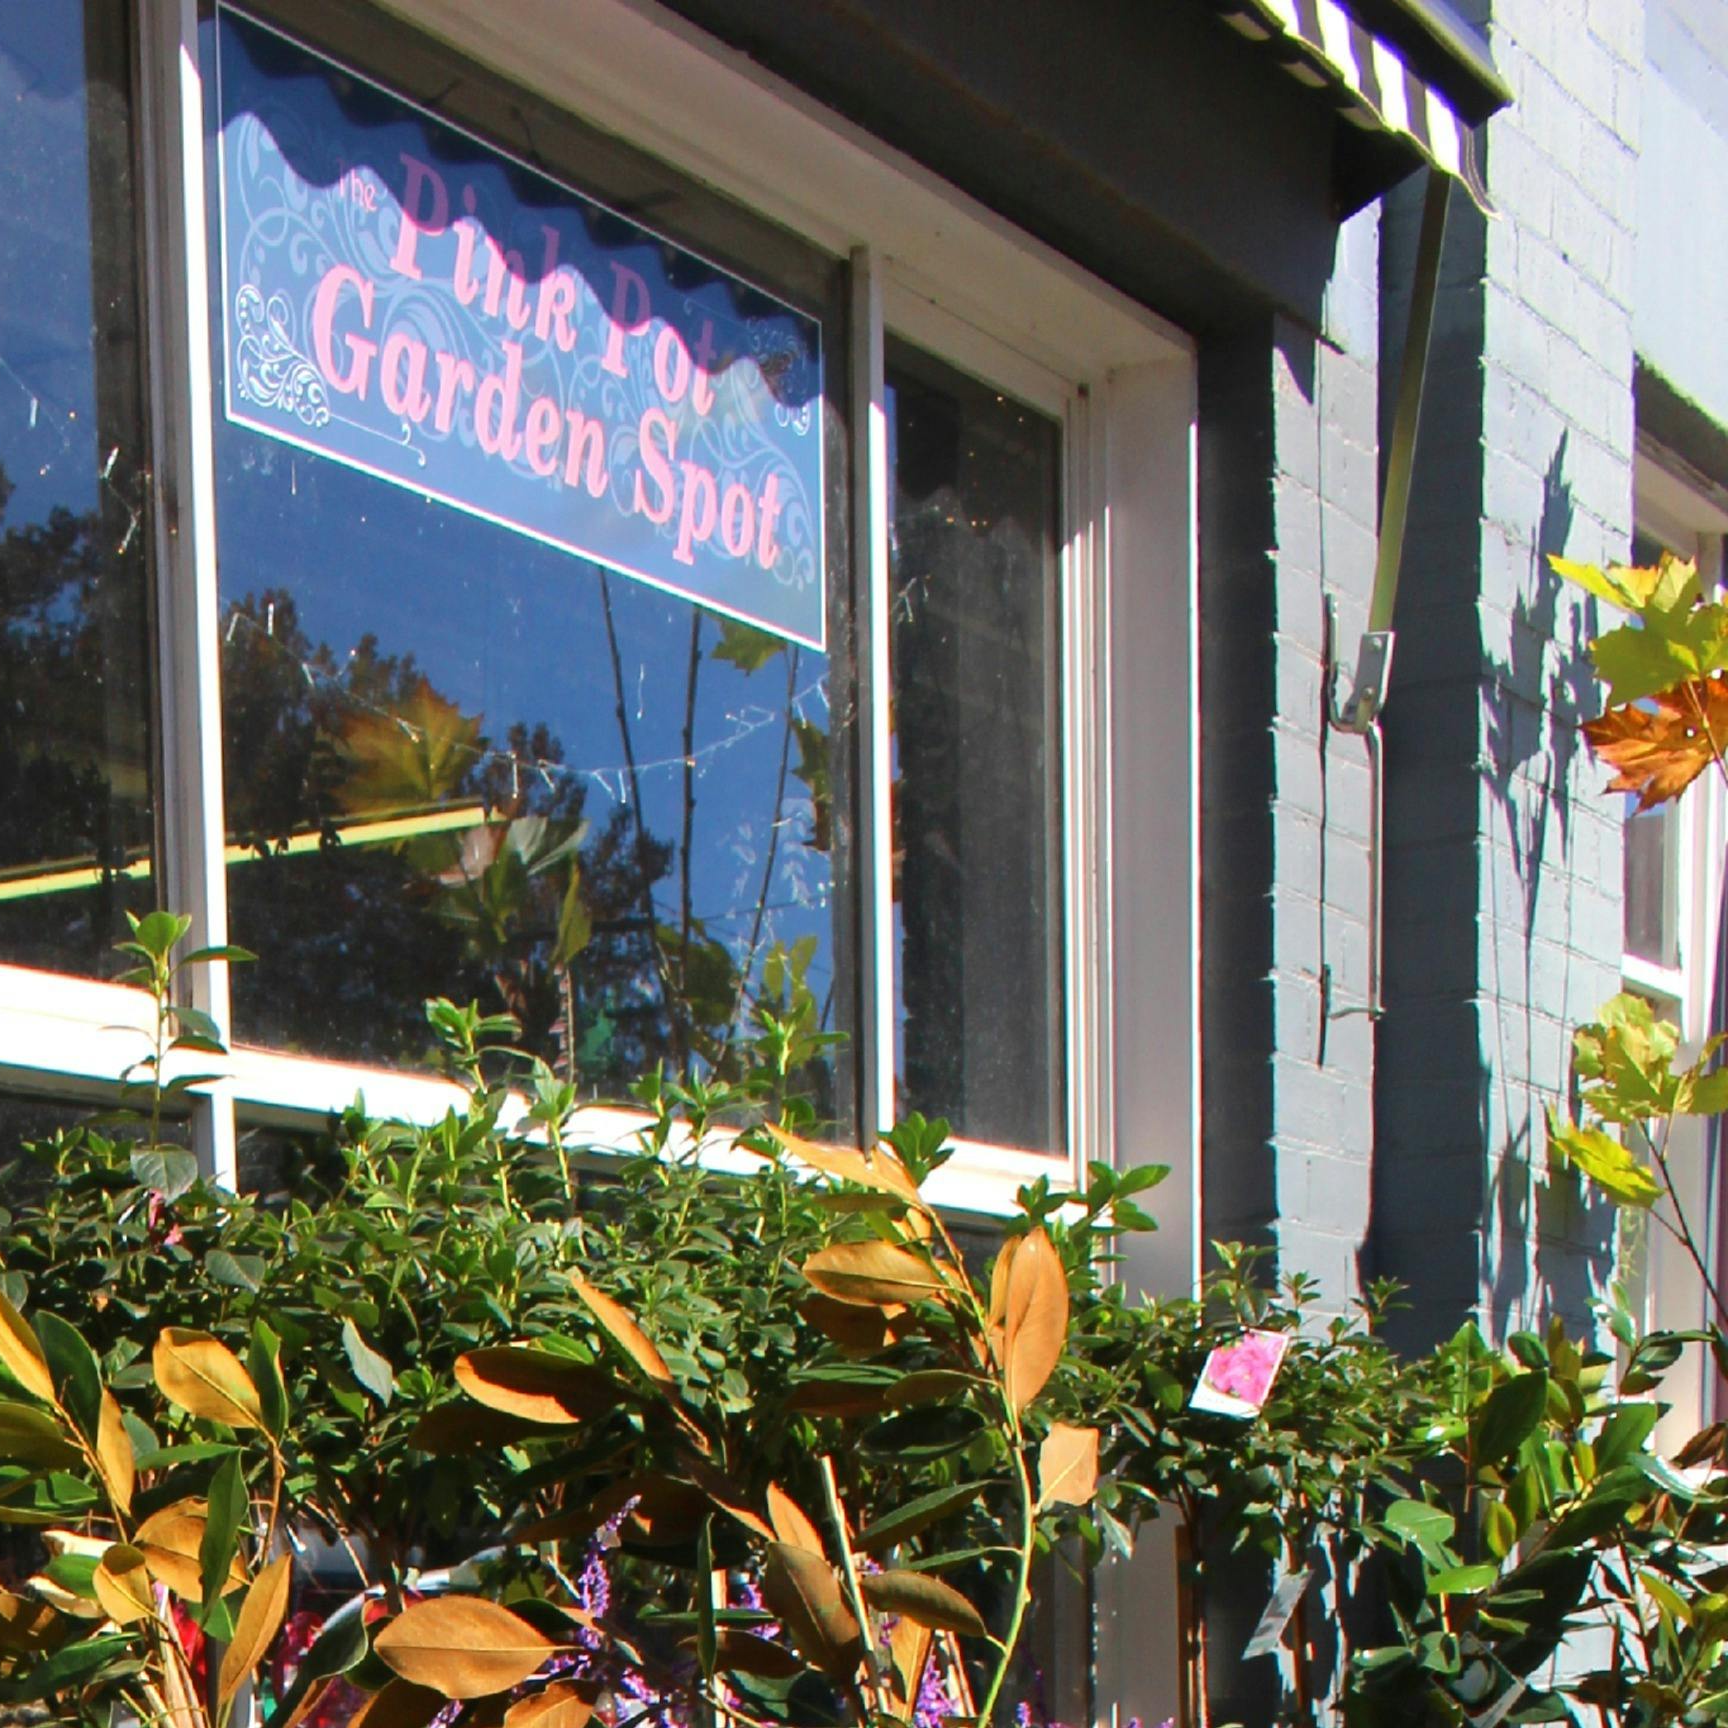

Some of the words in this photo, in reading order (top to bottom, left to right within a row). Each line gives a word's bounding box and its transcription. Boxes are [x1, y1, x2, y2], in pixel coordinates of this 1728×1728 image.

[312, 264, 609, 498] Garden
[634, 408, 780, 569] Spot
[390, 152, 576, 352] Pink
[602, 259, 715, 416] Pot
